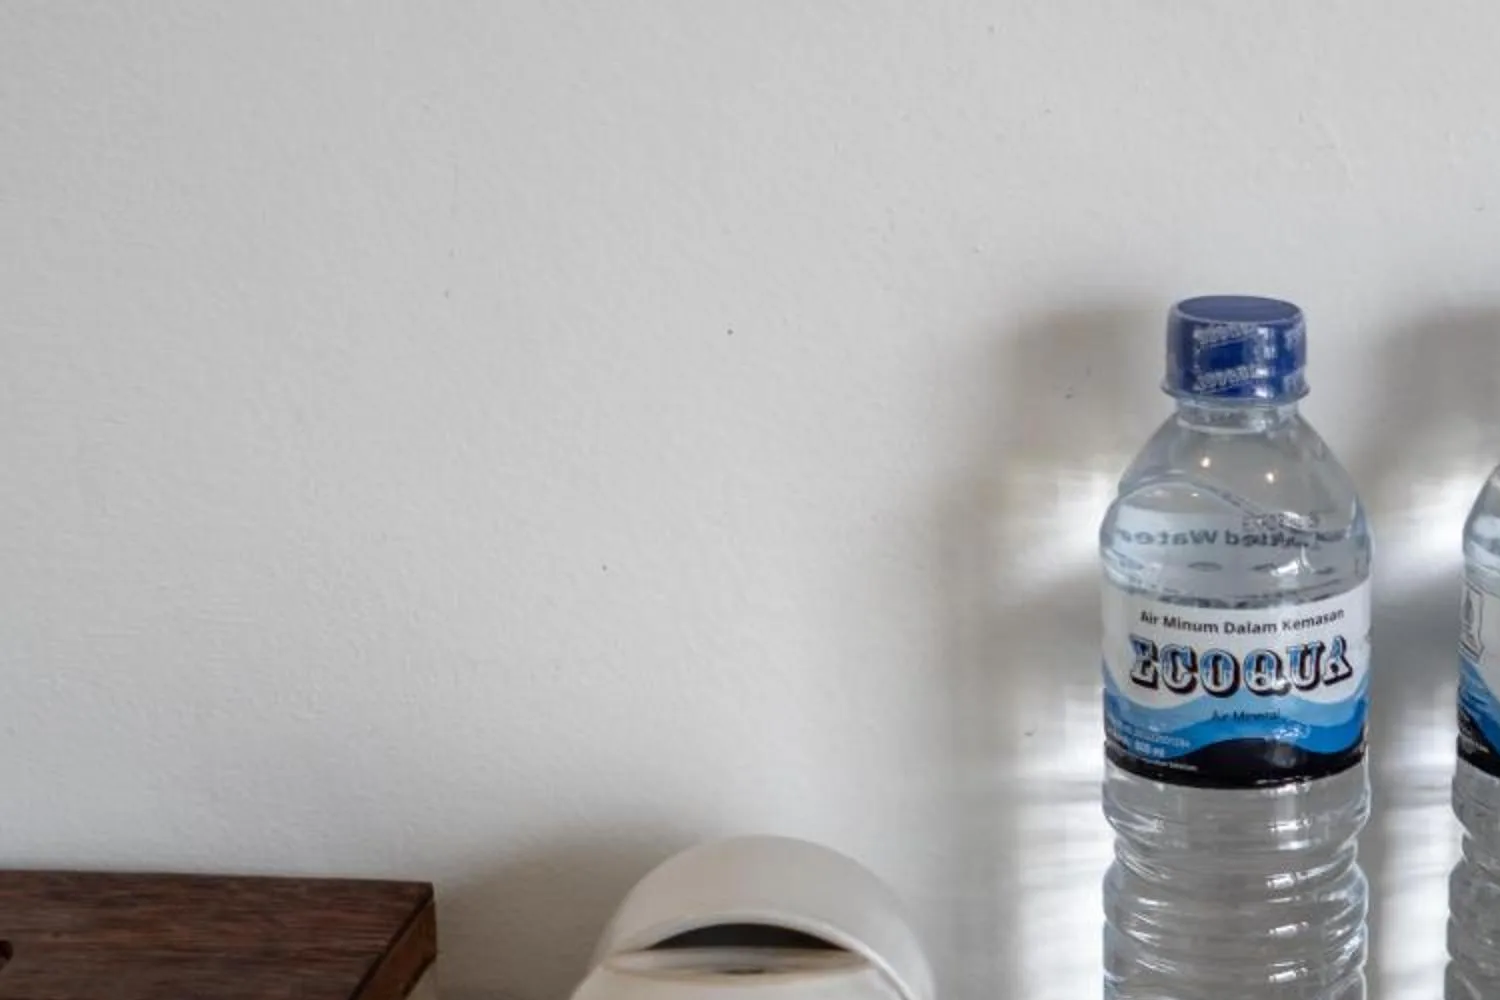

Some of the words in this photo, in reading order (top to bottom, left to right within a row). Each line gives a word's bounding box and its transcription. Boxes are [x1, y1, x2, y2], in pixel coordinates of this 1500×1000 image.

[1140, 610, 1159, 626] Air
[1163, 613, 1220, 634] Minum
[1223, 620, 1278, 635] Dalam
[1281, 608, 1345, 632] Kemasan
[1129, 633, 1354, 698] ECOQUA
